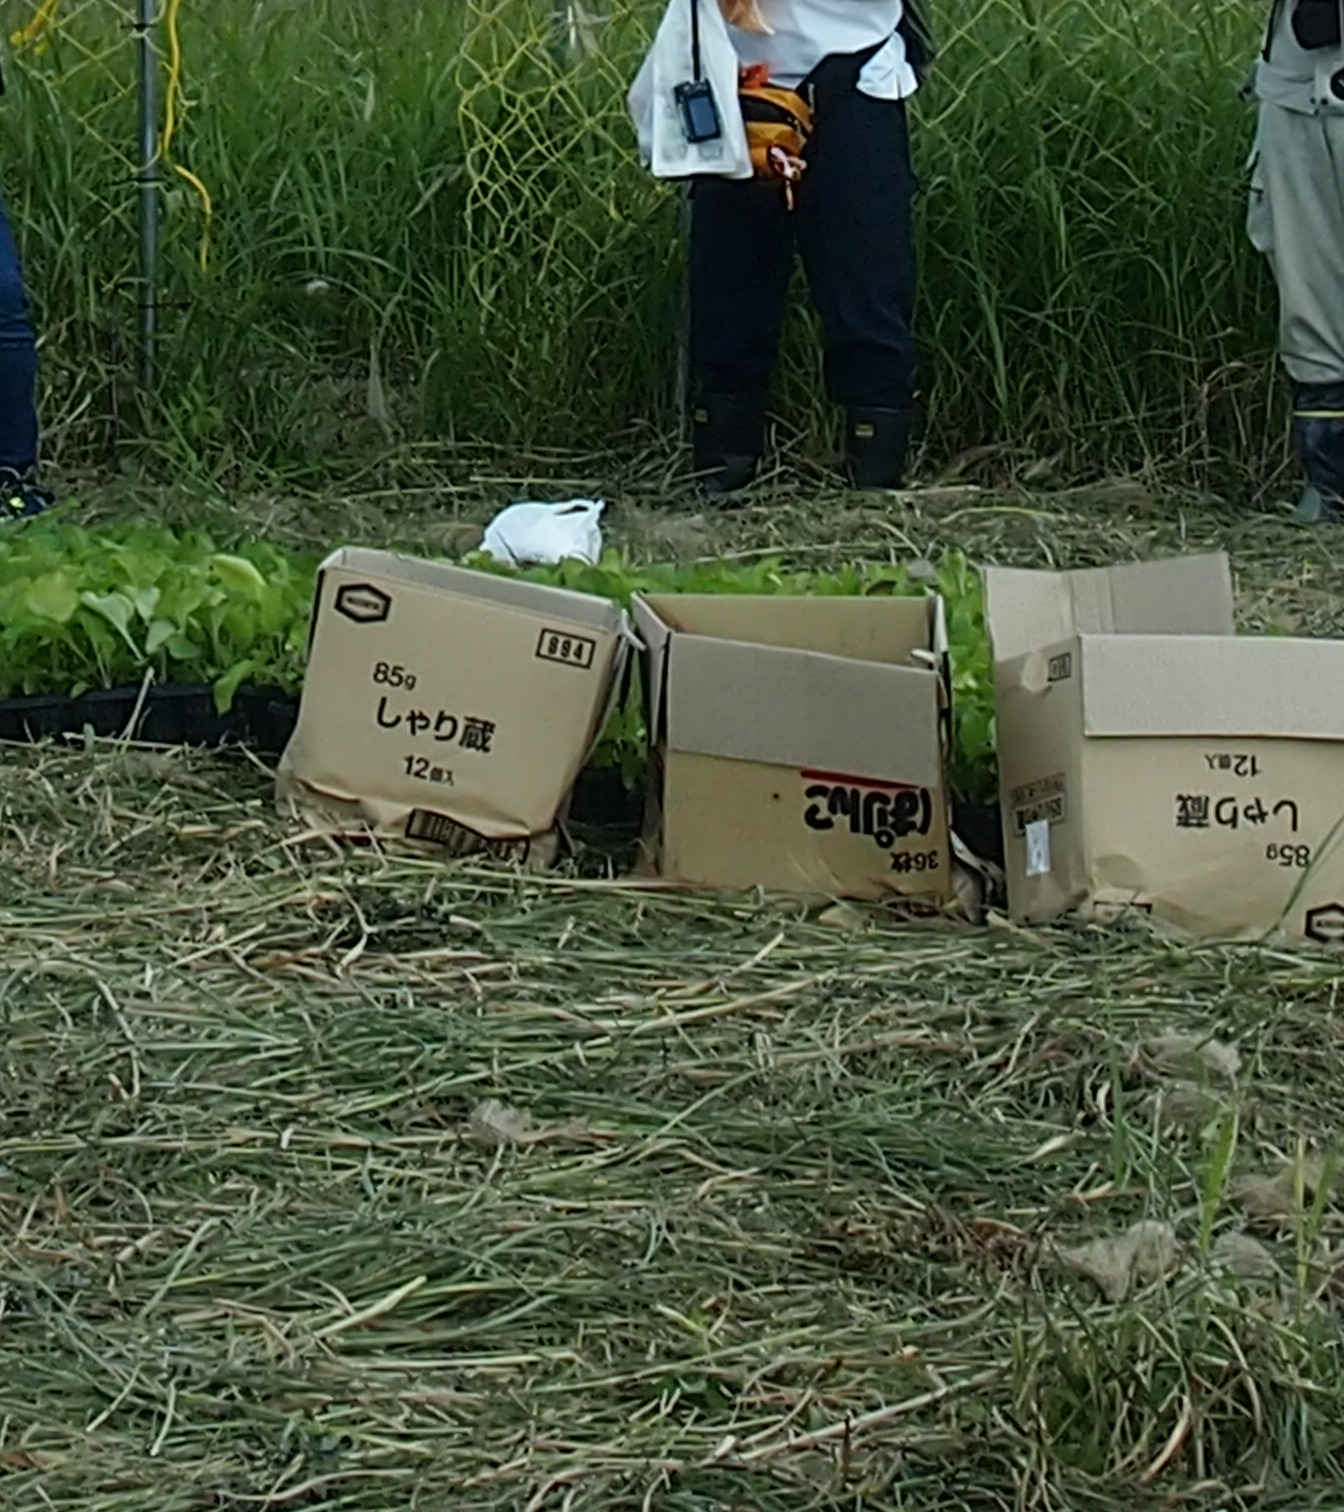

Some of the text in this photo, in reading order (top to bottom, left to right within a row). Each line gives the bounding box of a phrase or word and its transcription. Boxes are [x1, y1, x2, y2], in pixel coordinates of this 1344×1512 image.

[372, 661, 417, 691] 85g
[376, 695, 497, 753] しゃり蔵
[803, 785, 932, 850] ぱりんこ
[1175, 793, 1299, 833] しゃり蔵
[1266, 843, 1311, 868] 85g
